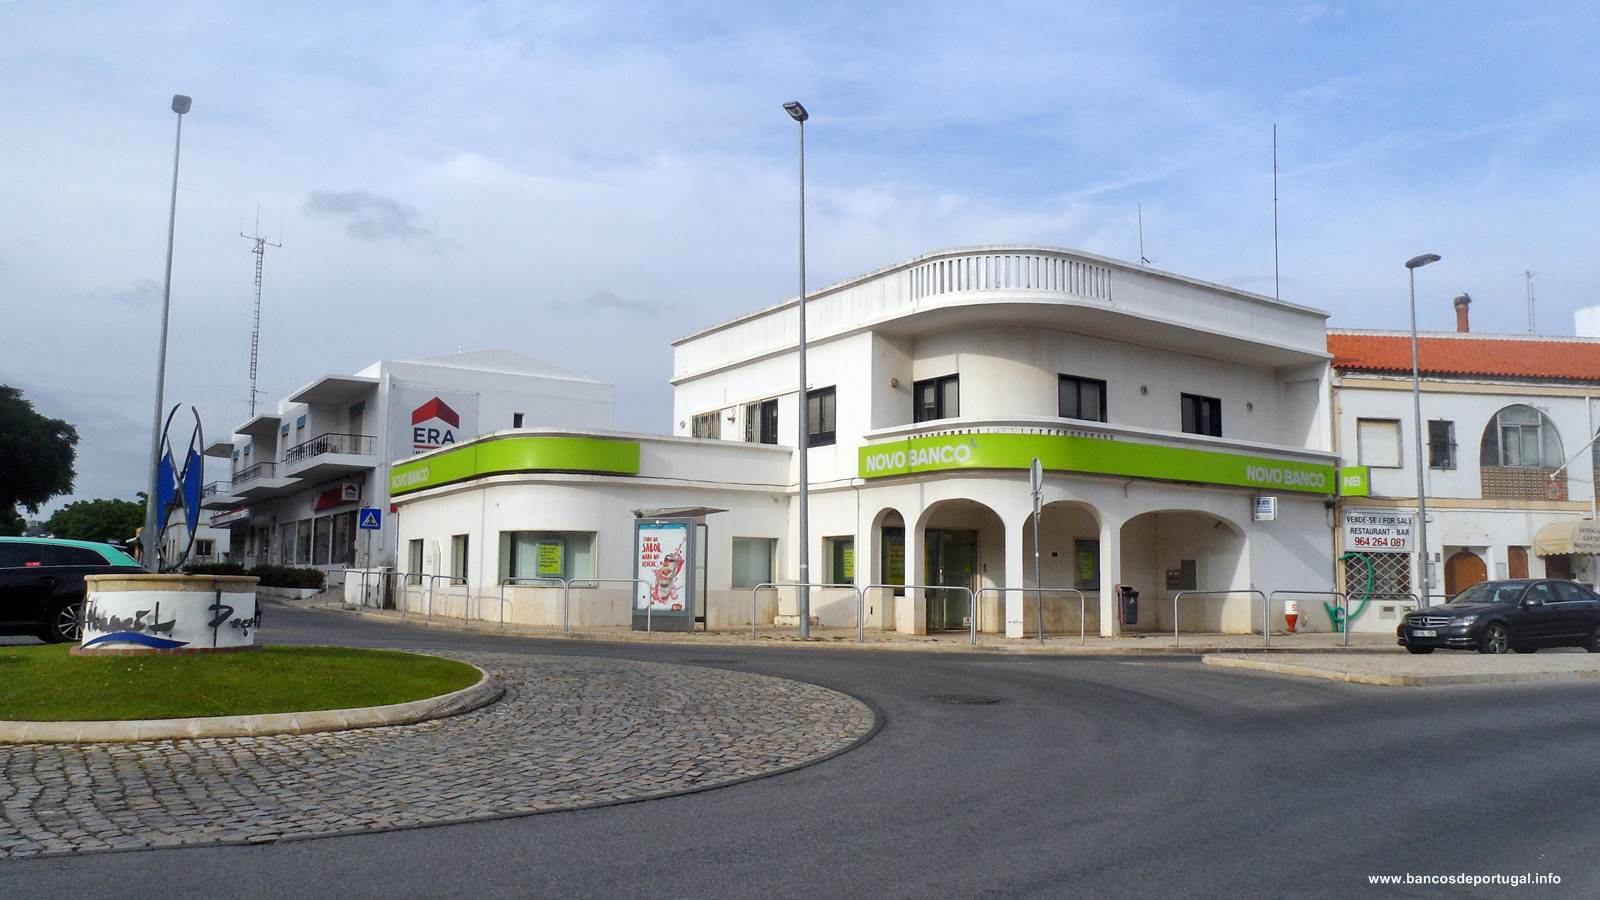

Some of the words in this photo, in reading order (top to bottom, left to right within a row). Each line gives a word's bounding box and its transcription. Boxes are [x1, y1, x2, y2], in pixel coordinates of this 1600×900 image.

[413, 427, 455, 445] ERA
[866, 451, 906, 472] NOVO
[908, 444, 970, 466] BANCO
[1246, 465, 1282, 483] NOVO
[1284, 468, 1325, 487] BANCO
[1343, 476, 1361, 487] NB
[1346, 516, 1377, 524] VENDE-SE
[1382, 516, 1395, 524] FOR
[1396, 517, 1412, 525] SALE
[1350, 527, 1390, 535] RESTAURANT
[1354, 536, 1370, 546] 964
[1372, 537, 1388, 547] 264
[1390, 537, 1405, 547] 081
[642, 542, 661, 553] SABOR
